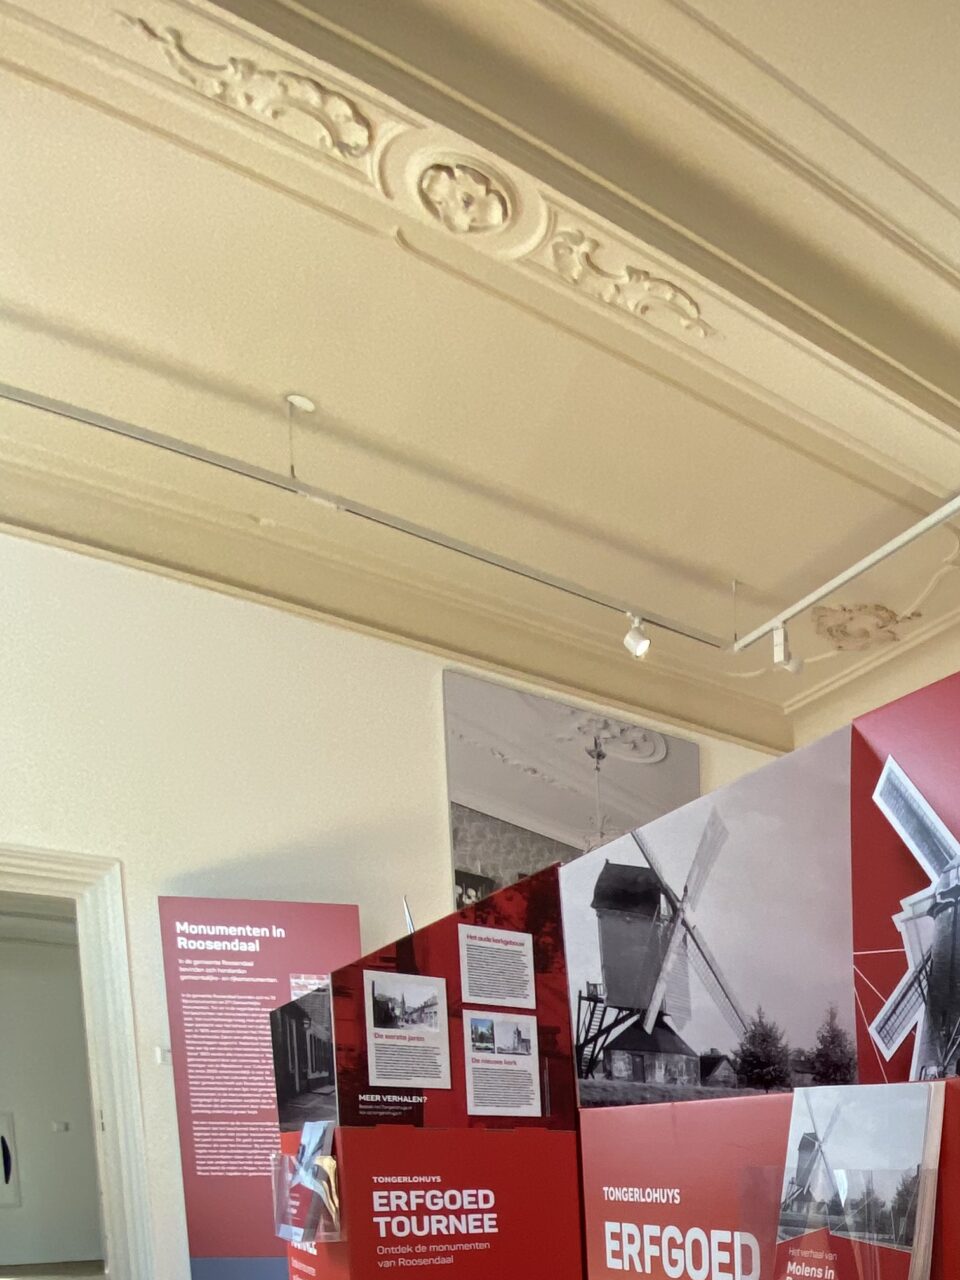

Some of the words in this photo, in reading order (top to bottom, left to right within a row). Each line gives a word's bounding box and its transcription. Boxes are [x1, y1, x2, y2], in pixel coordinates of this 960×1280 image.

[175, 921, 270, 938] Monumenten
[272, 925, 286, 938] in
[176, 937, 260, 952] Roosendaal
[358, 1094, 381, 1102] MEER
[382, 1095, 428, 1103] VERHALEN?
[372, 1175, 442, 1184] TONGERLOHUYS
[372, 1189, 495, 1212] ERFGOED
[603, 1186, 681, 1204] TONGERLOHUYS
[372, 1213, 499, 1237] TOURNEE
[376, 1245, 413, 1255] Ontdek
[415, 1243, 427, 1253] de
[429, 1241, 491, 1252] monumenten
[378, 1260, 395, 1268] van
[398, 1255, 454, 1267] Roosendaal
[786, 1261, 823, 1277] Molens
[824, 1265, 835, 1280] in
